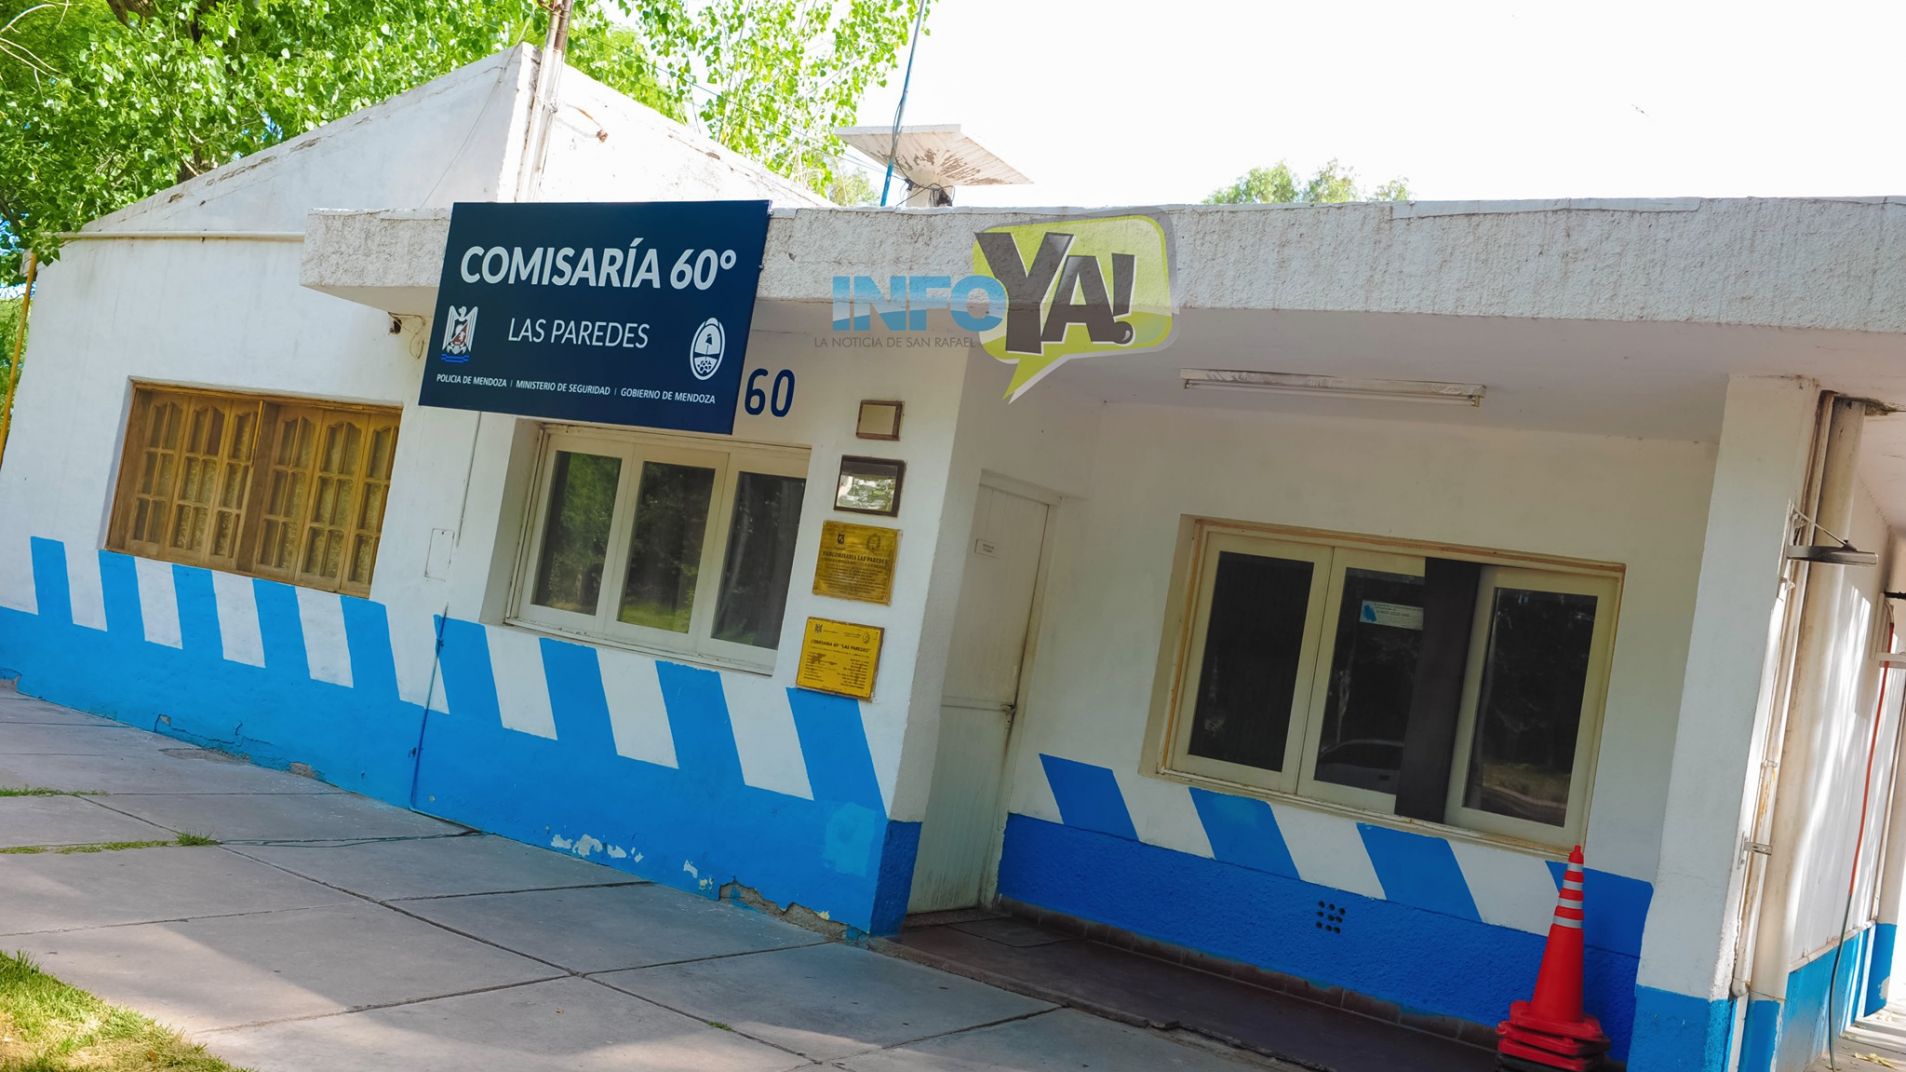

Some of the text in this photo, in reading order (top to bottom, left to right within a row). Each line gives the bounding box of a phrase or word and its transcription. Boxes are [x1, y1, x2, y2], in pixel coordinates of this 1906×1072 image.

[460, 237, 661, 289] COMISARÍA
[508, 317, 650, 349] LAS PAREDES
[436, 373, 716, 404] POLICIA DE MENDOZA MINISTERIO DE SEGURIDAD GOBIERNO DE MENDOZA
[744, 368, 796, 418] 60
